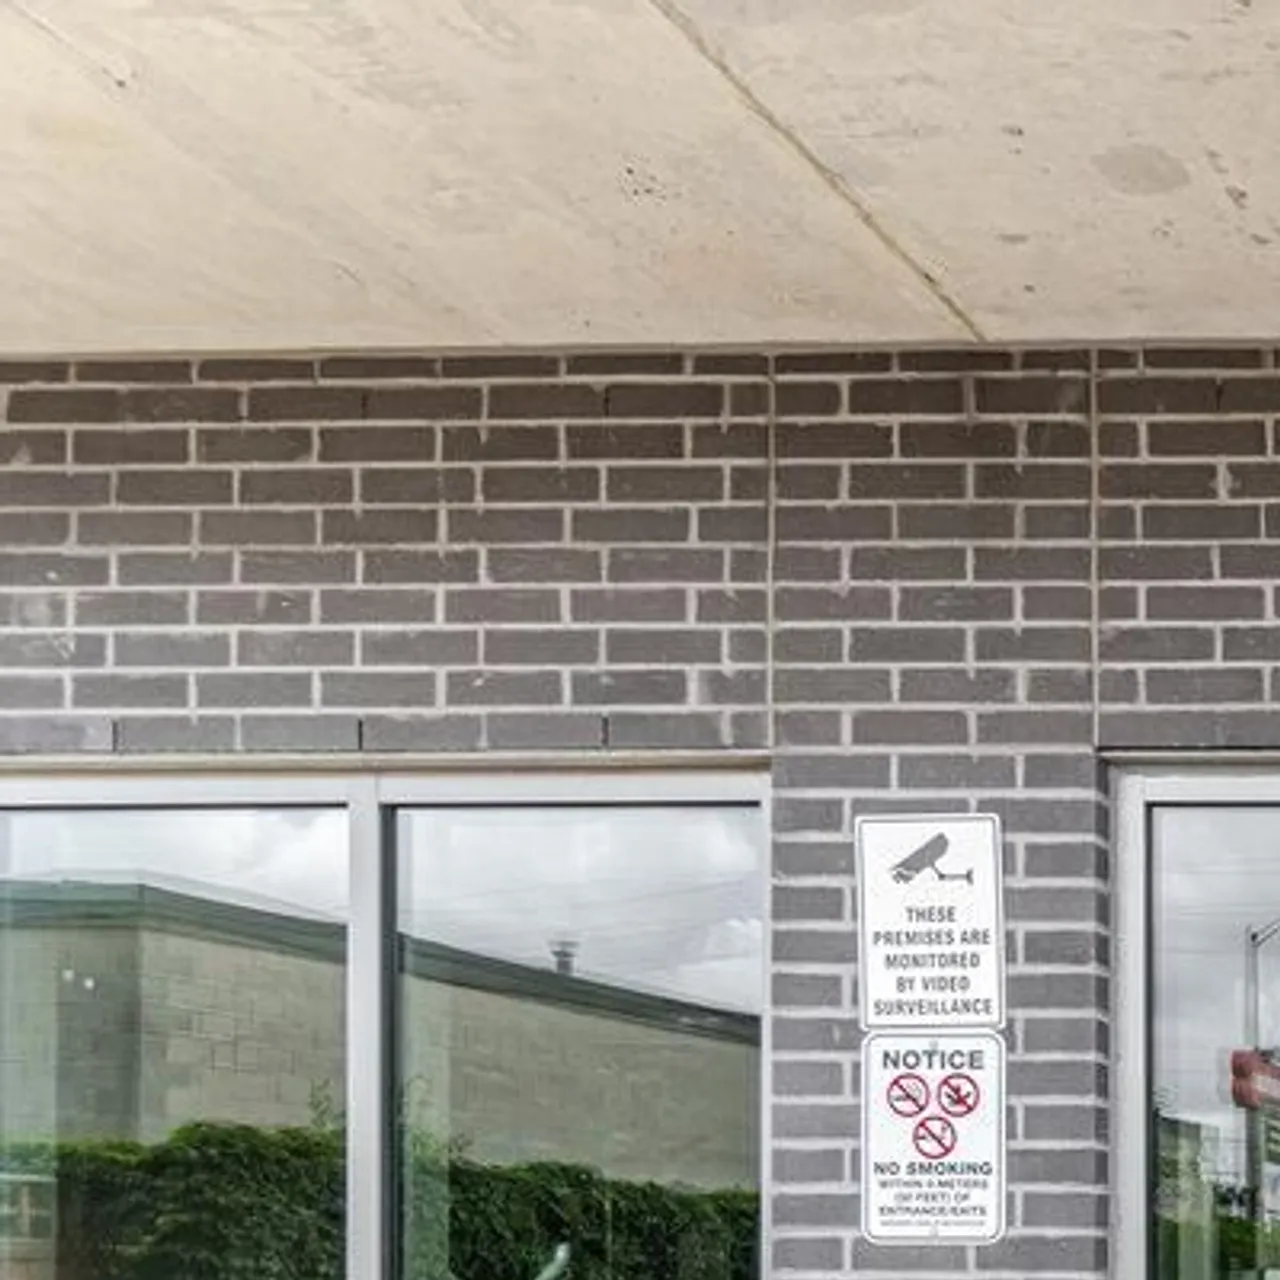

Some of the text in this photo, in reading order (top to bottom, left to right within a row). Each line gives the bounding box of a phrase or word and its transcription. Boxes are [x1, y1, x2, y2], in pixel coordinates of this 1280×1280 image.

[905, 906, 957, 923] THESE
[873, 929, 991, 946] PREMISES ARE
[885, 953, 981, 969] MONITORED
[896, 976, 971, 993] BY VIDEO
[873, 999, 993, 1016] SURVEILLANCE
[883, 1050, 984, 1070] NOTICE
[873, 1162, 993, 1175] NO SMOKING
